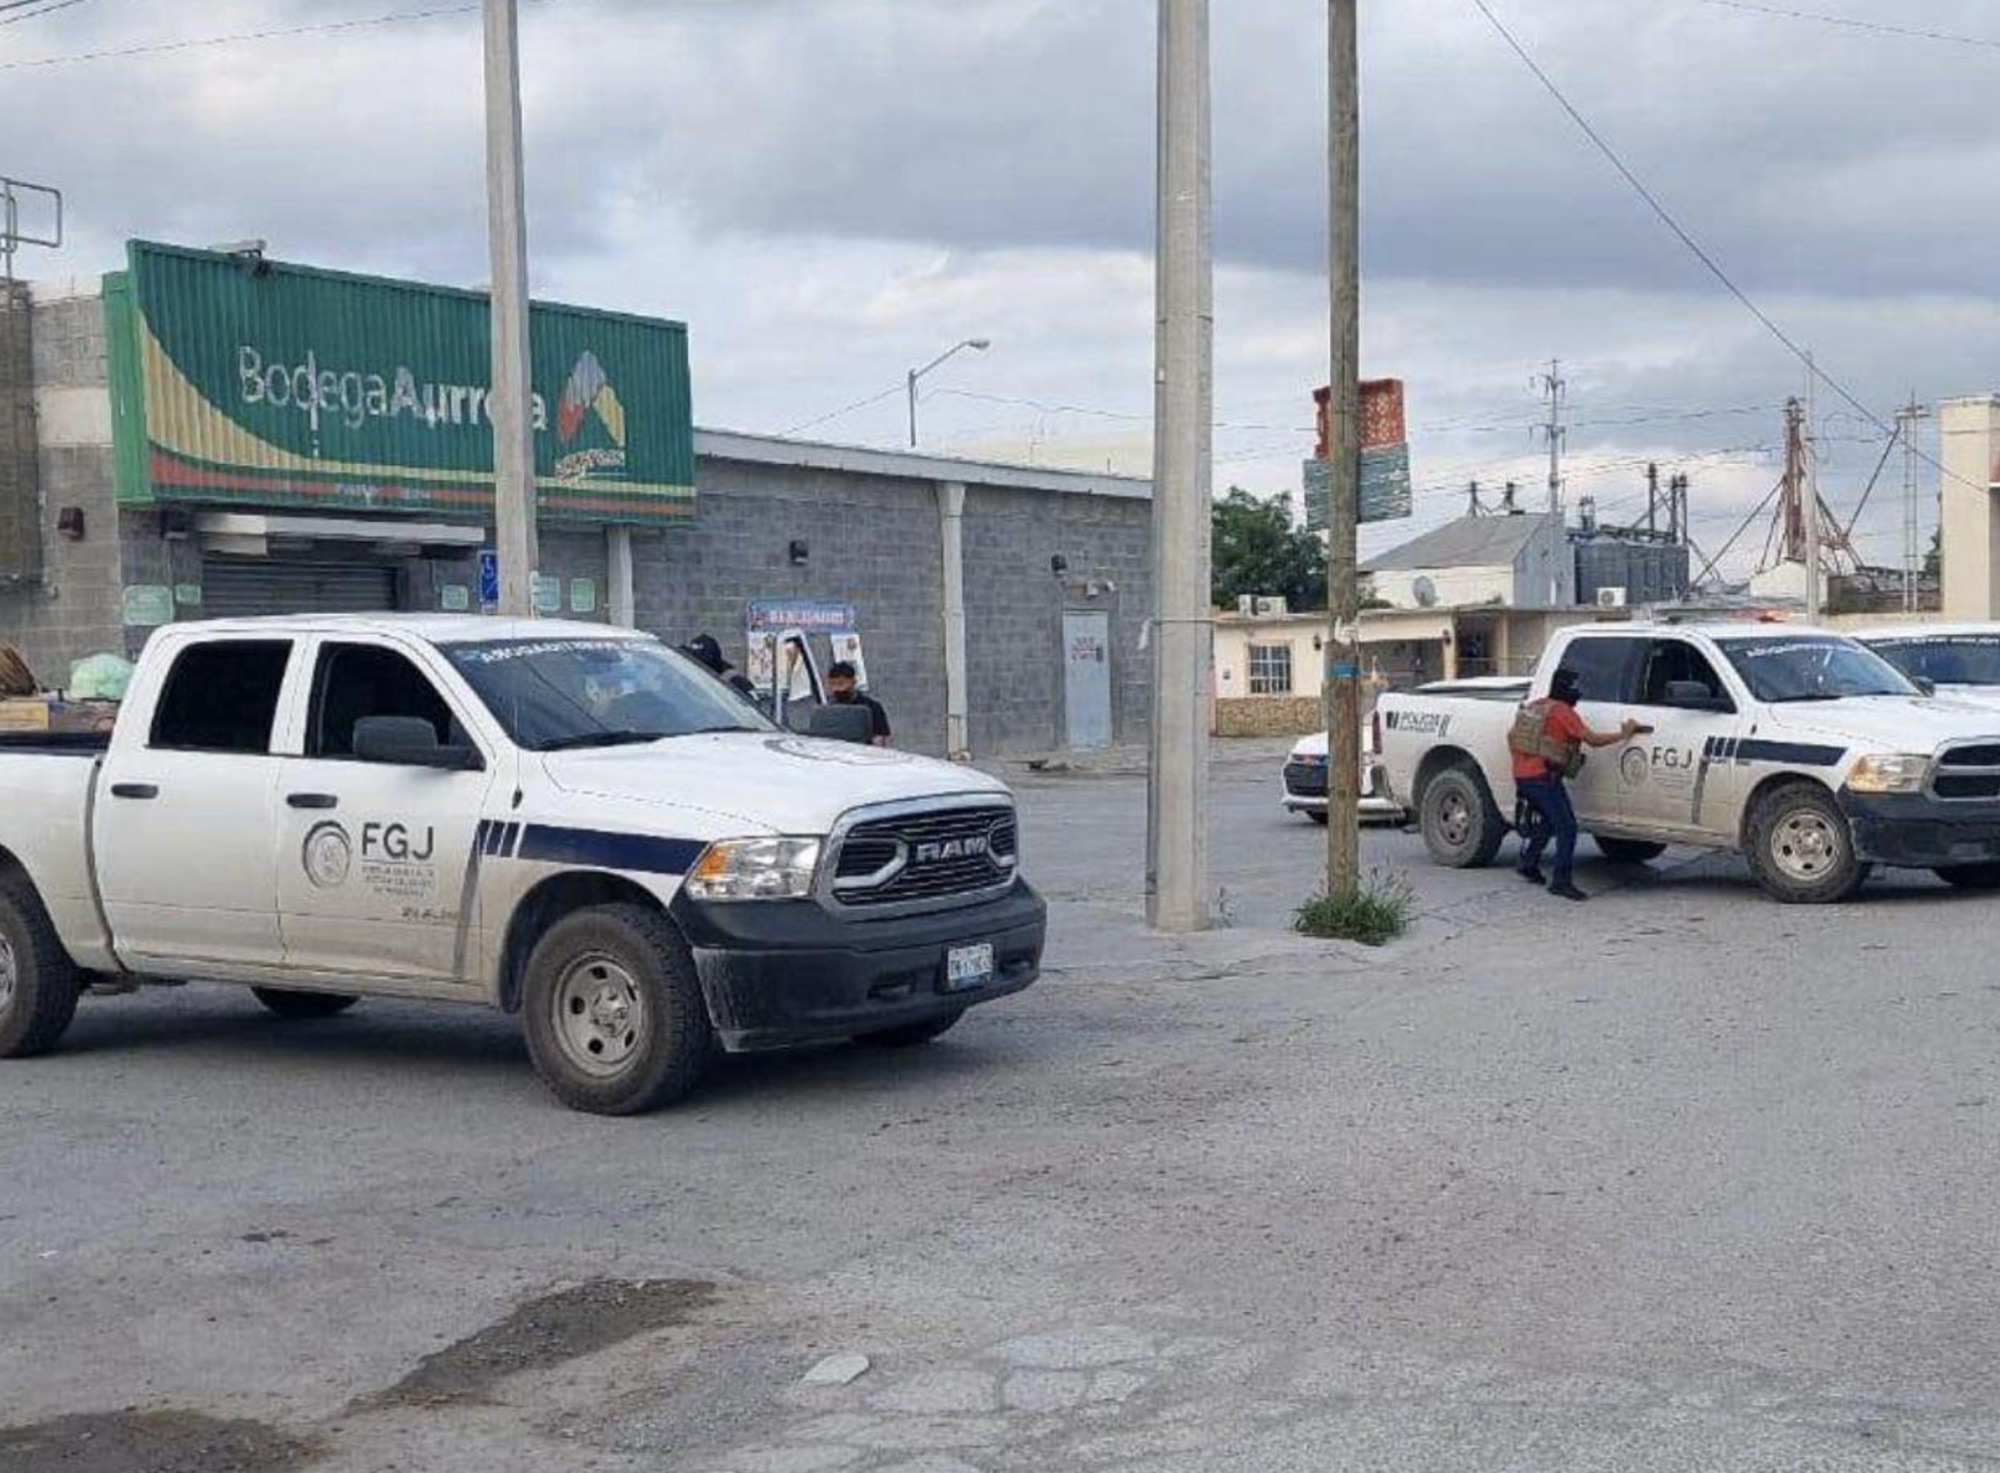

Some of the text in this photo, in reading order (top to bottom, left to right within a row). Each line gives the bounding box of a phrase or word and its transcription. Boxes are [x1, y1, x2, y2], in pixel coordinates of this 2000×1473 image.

[238, 345, 548, 432] Bodega Aurra
[1651, 746, 1693, 769] FGJ
[362, 822, 434, 860] FGJ
[916, 837, 988, 862] RAM
